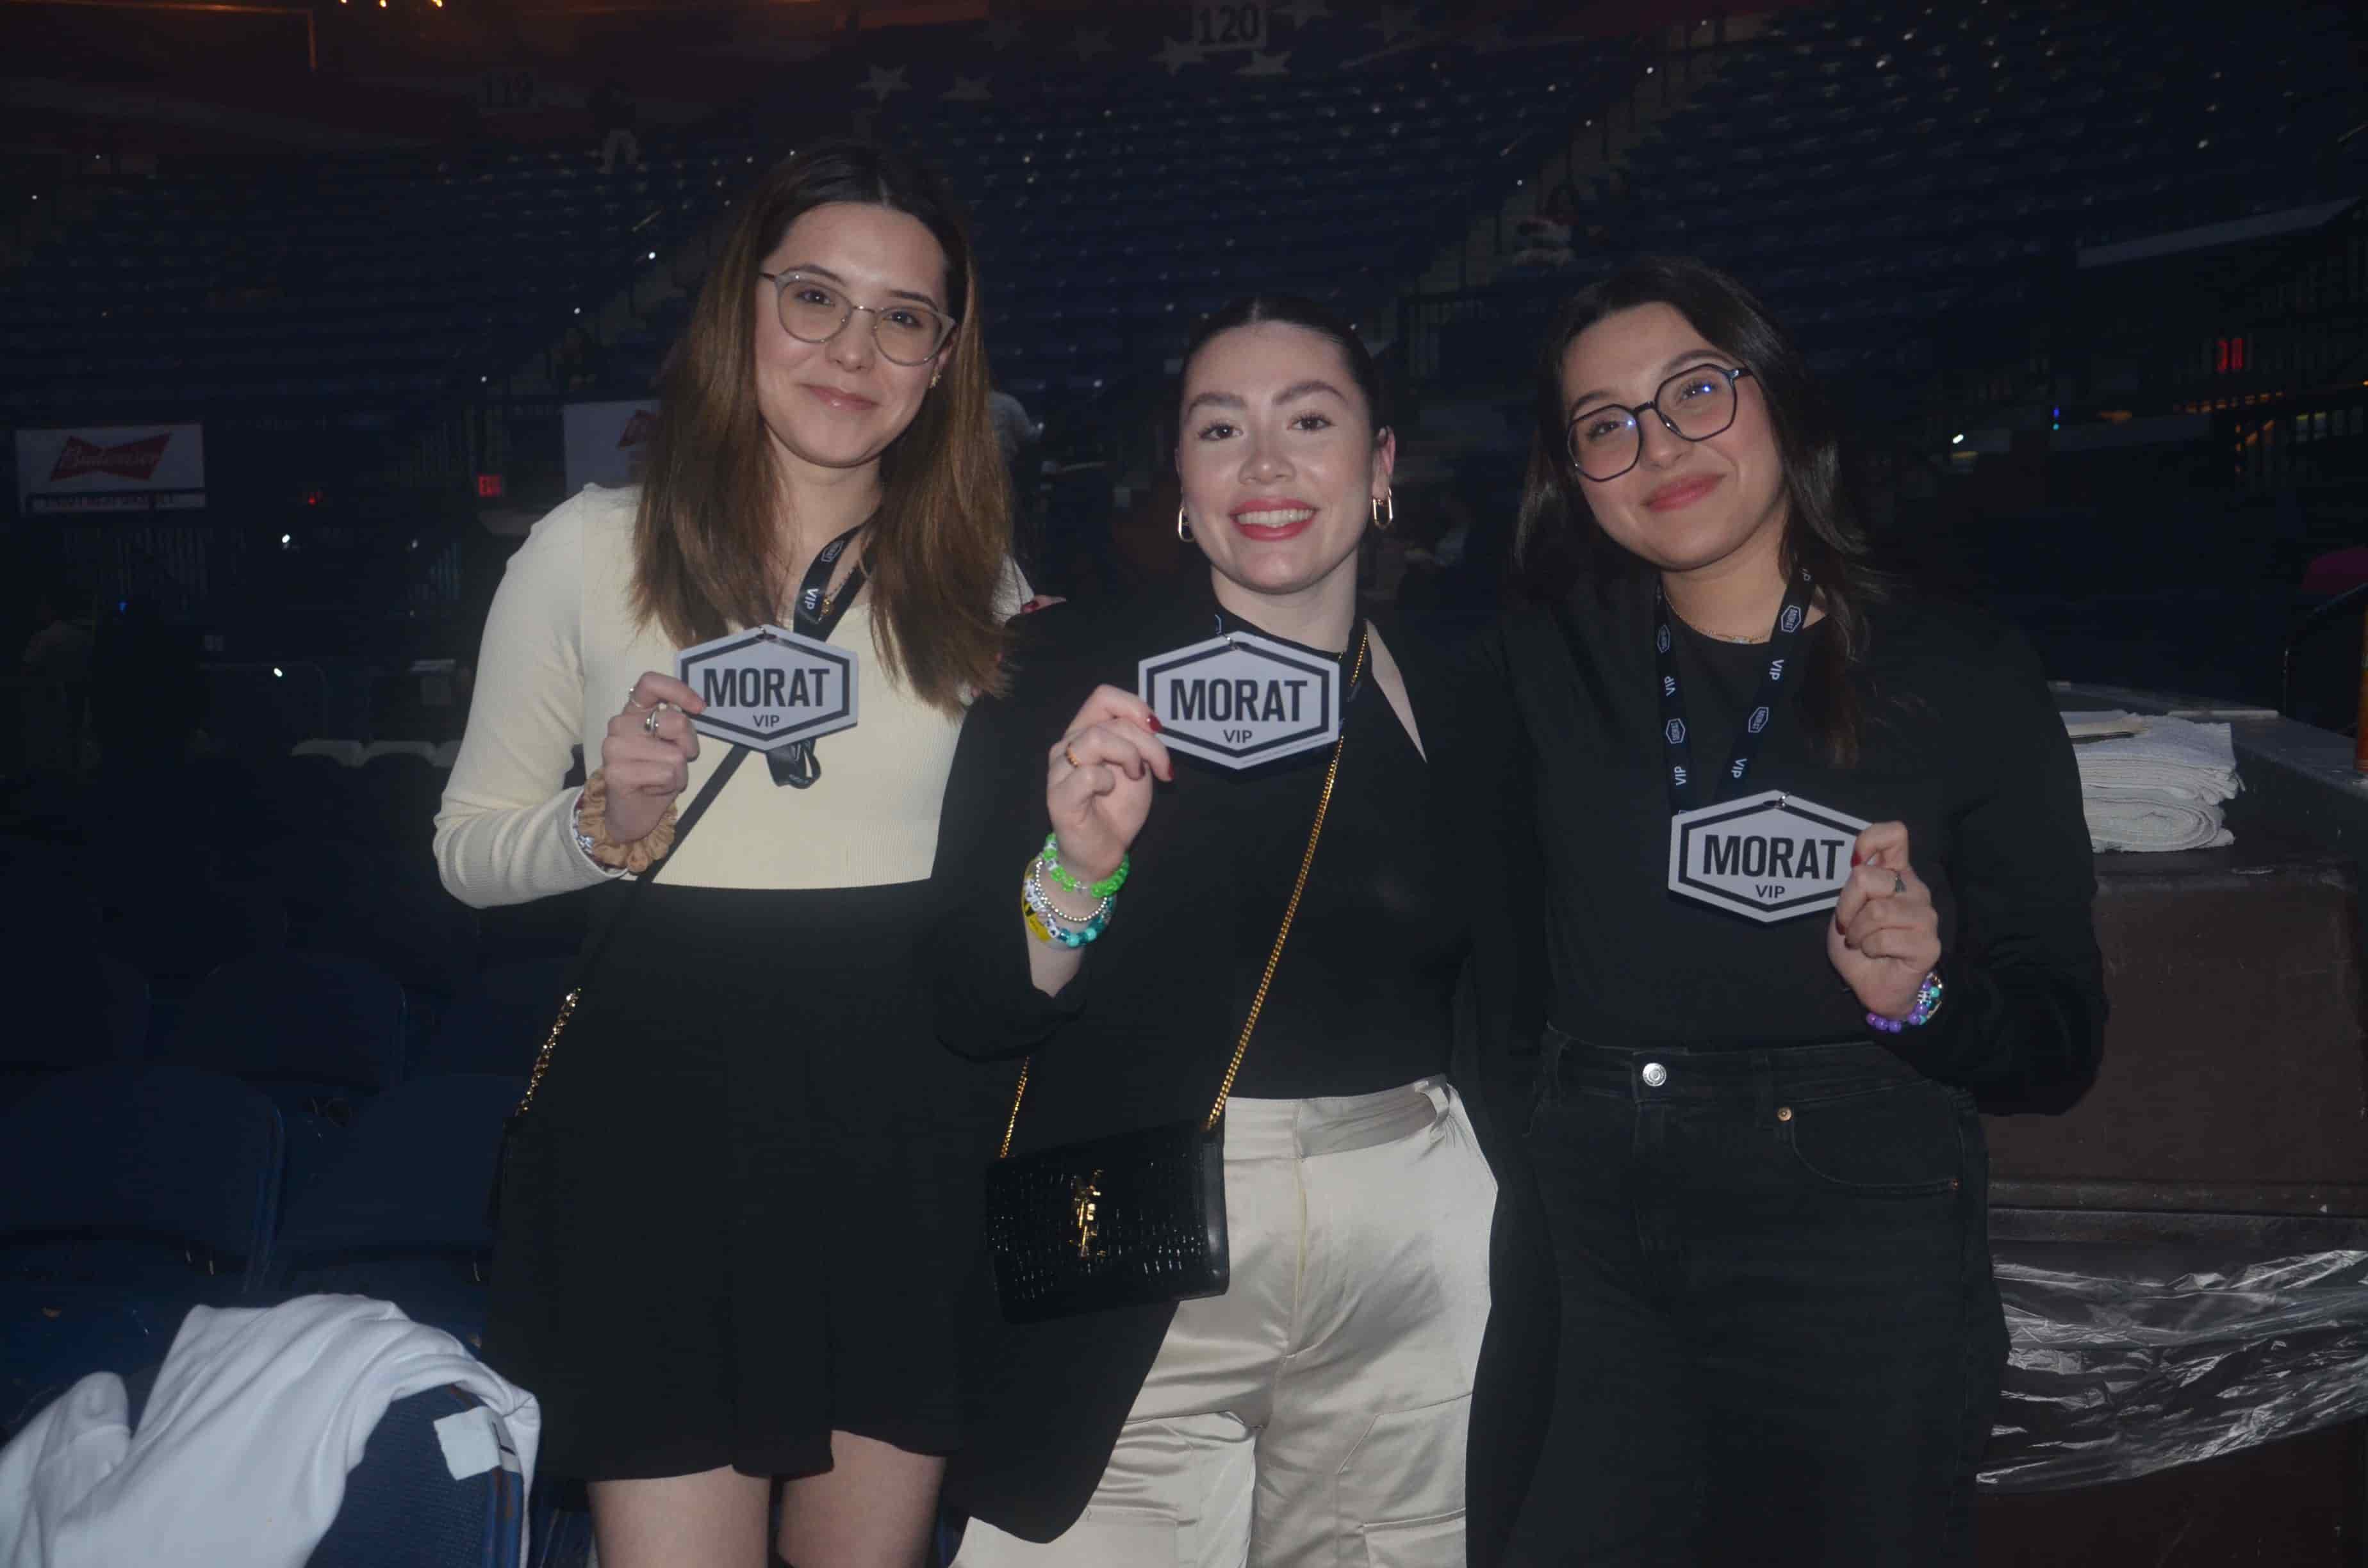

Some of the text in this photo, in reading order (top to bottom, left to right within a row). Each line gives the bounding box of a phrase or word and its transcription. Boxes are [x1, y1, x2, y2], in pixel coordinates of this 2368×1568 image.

[1199, 3, 1259, 45] 120
[804, 589, 819, 610] VIP
[1769, 659, 1784, 680] VIP
[703, 667, 830, 708] MORAT
[1664, 676, 1675, 697] VIP
[1171, 678, 1308, 722] MORAT
[753, 714, 780, 728] VIP
[1223, 729, 1253, 744] VIP
[1674, 766, 1687, 786] VIP
[1731, 758, 1747, 779] VIP
[1703, 834, 1845, 880] MORAT
[1755, 884, 1786, 899] VIP
